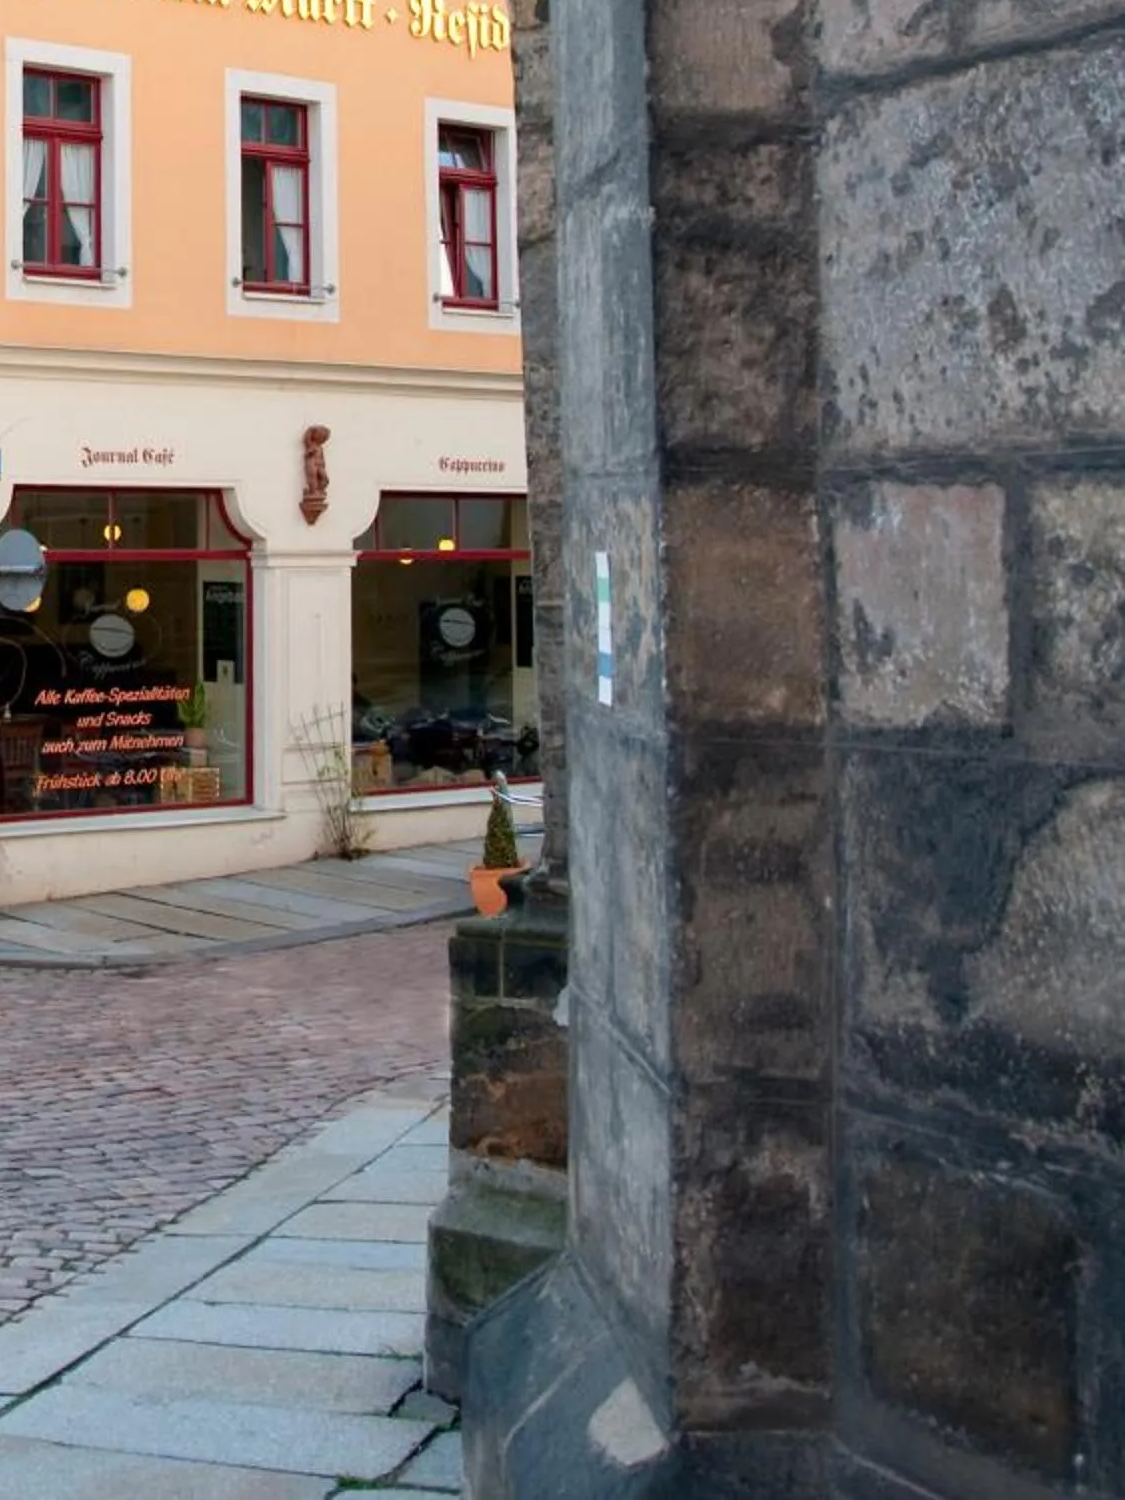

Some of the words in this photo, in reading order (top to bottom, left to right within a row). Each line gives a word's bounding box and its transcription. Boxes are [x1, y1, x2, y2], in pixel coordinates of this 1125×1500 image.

[81, 447, 138, 468] Journal
[35, 689, 61, 706] Alle
[76, 711, 103, 729] und
[105, 710, 152, 727] Snacks
[42, 738, 74, 754] auch
[75, 739, 107, 754] zum
[108, 734, 185, 751] Mitnehmen
[35, 773, 100, 793] Frühstück
[105, 771, 121, 786] ab
[125, 767, 158, 786] 8.00
